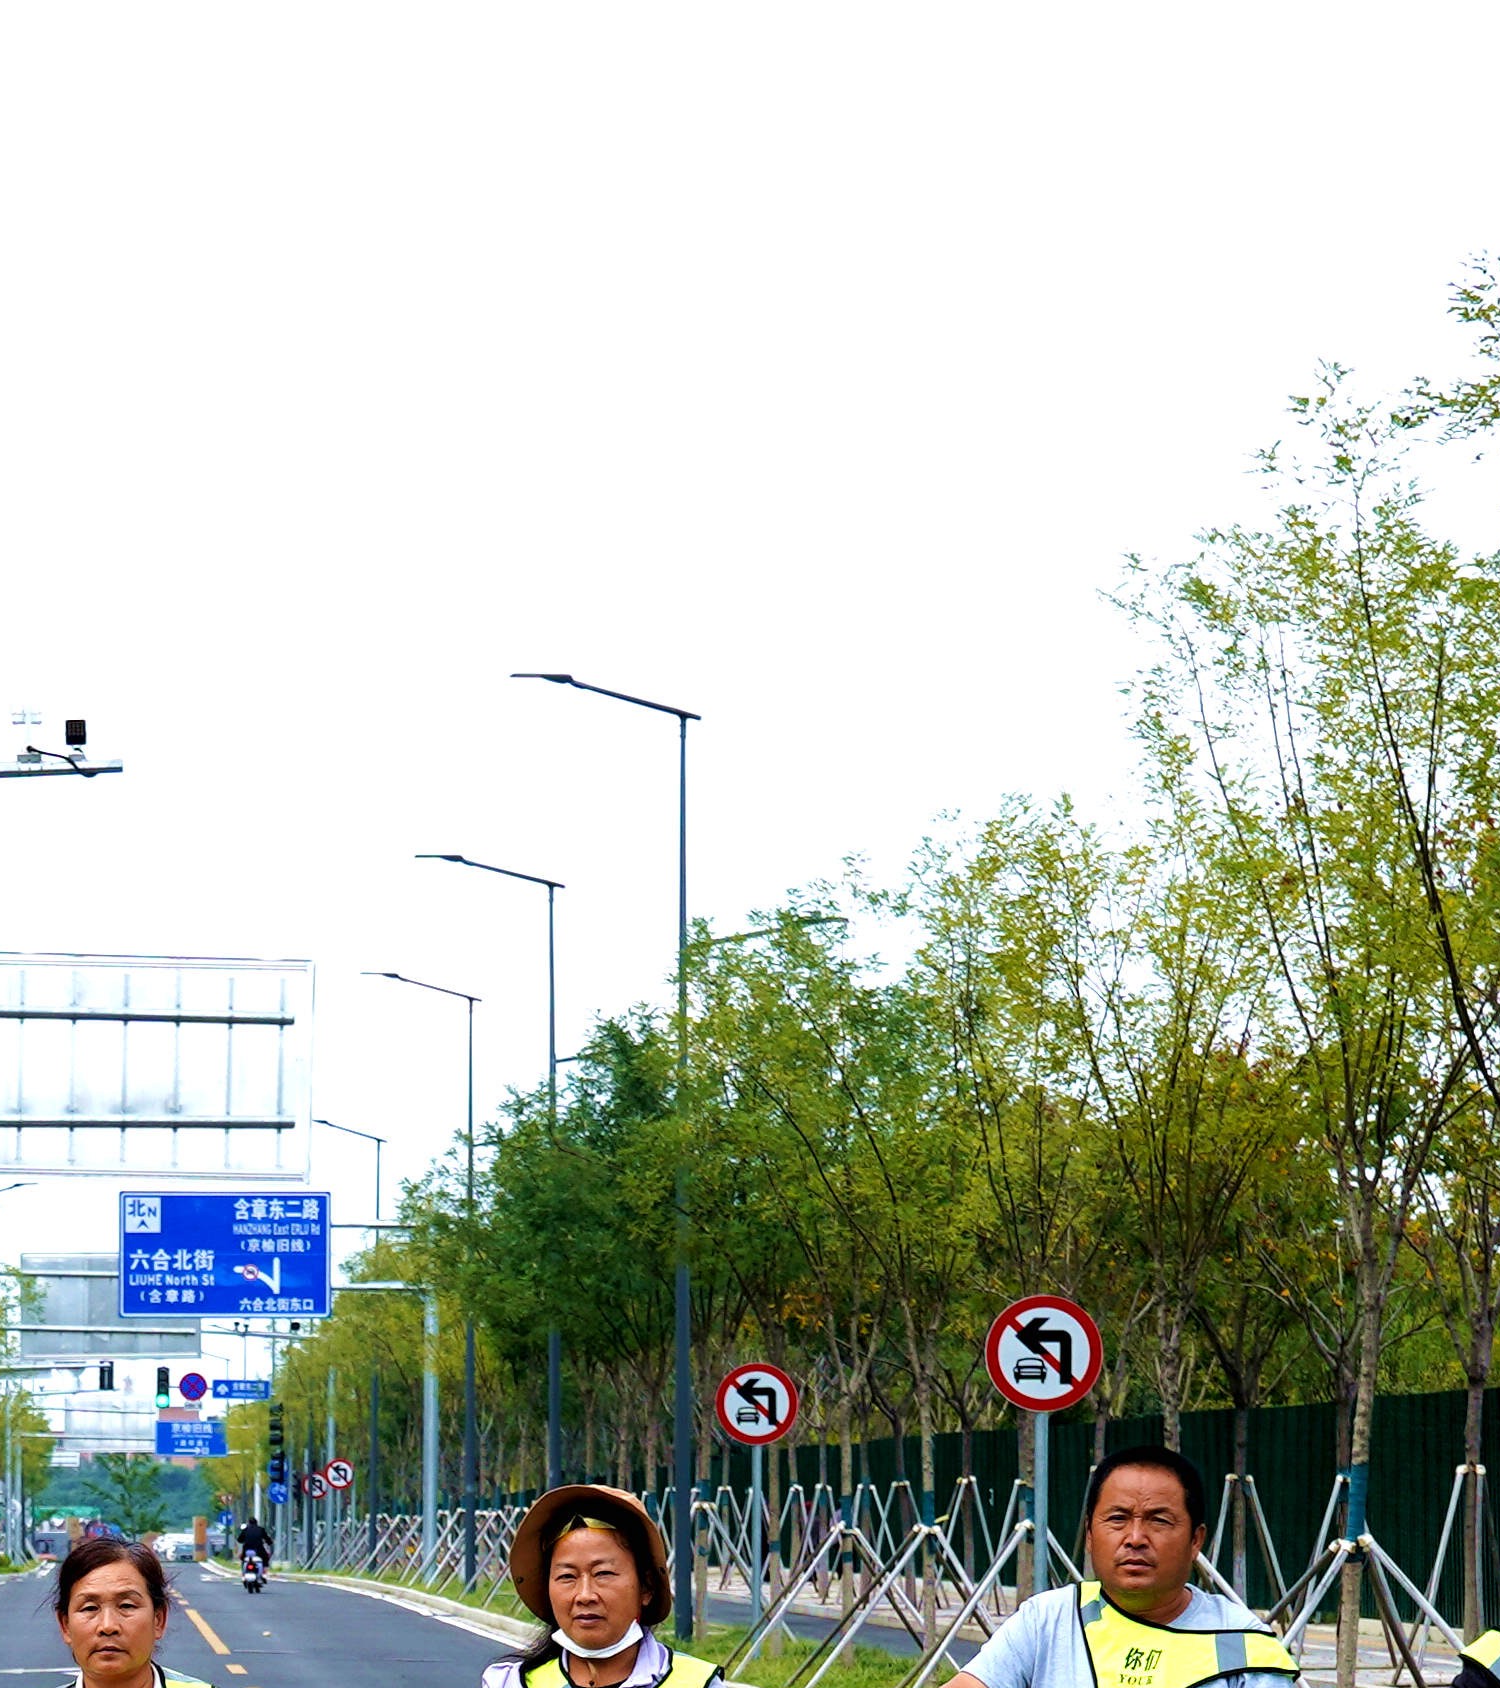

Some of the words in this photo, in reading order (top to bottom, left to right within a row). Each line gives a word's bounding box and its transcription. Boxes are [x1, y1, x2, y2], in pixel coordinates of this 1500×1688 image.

[128, 1199, 145, 1217] 北
[147, 1206, 157, 1217] N
[233, 1198, 320, 1220] 含章东二路
[129, 1248, 215, 1271] 六合北街
[129, 1275, 162, 1287] LIUHE
[165, 1275, 198, 1287] North
[201, 1275, 215, 1287] St
[239, 1298, 314, 1311] 六合北街东口
[1124, 1647, 1163, 1671] 你们
